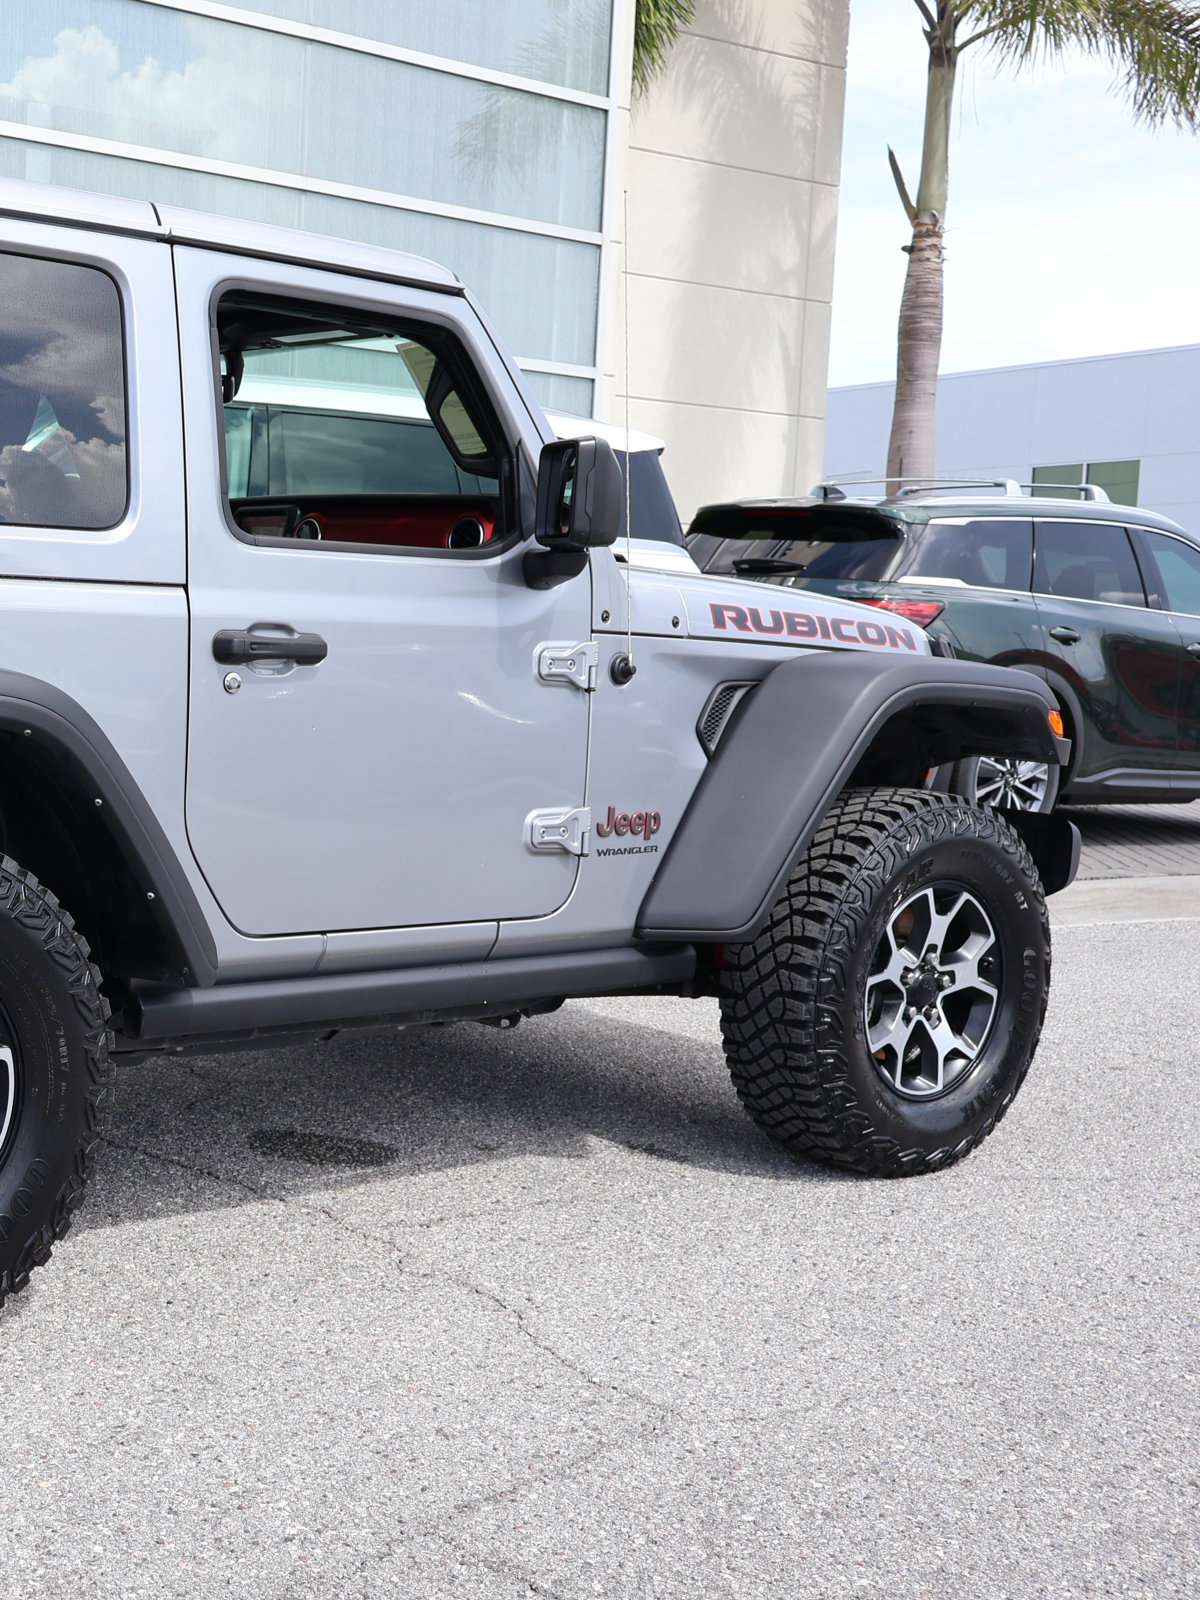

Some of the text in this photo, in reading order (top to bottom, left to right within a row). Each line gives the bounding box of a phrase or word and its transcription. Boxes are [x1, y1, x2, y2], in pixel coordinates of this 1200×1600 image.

[709, 603, 917, 651] RUBICON
[596, 806, 661, 840] Jeep
[596, 845, 658, 857] WRANGLER
[1013, 891, 1028, 910] MT
